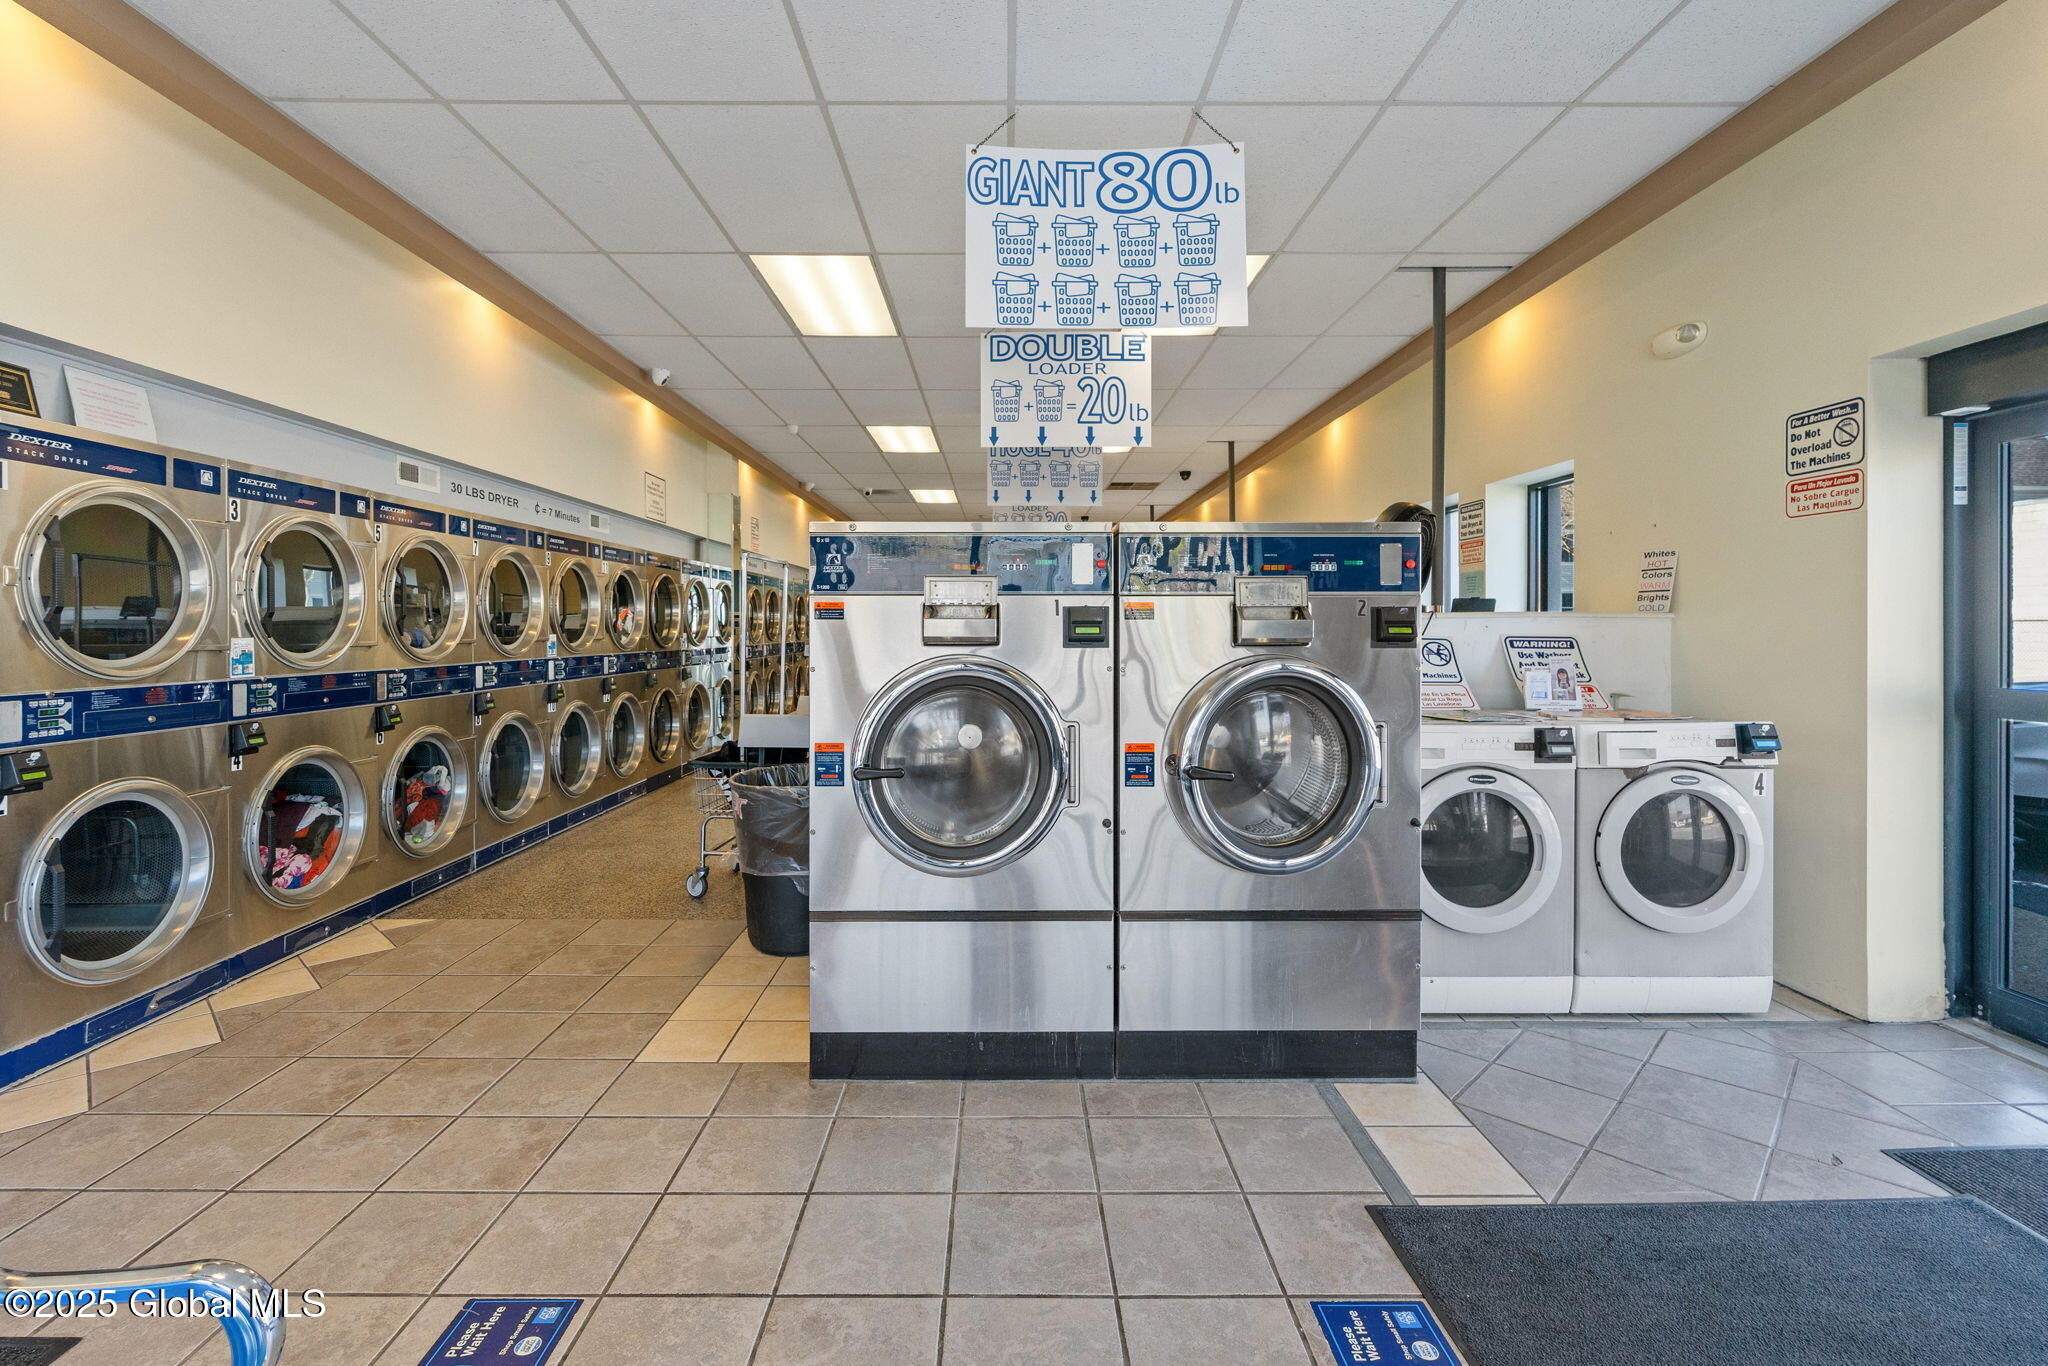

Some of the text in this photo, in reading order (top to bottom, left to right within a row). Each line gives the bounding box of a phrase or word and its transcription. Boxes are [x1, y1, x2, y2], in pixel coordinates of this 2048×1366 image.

[967, 156, 1095, 208] GIANT
[1096, 149, 1212, 214] 80
[990, 334, 1146, 362] DOUBLE
[1028, 363, 1106, 375] LOADER
[1077, 376, 1148, 424] 20 lb
[1810, 412, 1830, 423] Better
[8, 432, 73, 451] DEXTER
[1791, 429, 1821, 442] Do Not
[7, 446, 88, 466] STACK DRYER
[1791, 439, 1832, 456] Overload
[1791, 452, 1851, 470] The Machines
[238, 477, 277, 490] DEXTER
[238, 487, 287, 500] STACK DRYER
[1804, 492, 1827, 501] Sobre
[1830, 487, 1860, 497] Cargue
[230, 500, 238, 521] 3
[450, 482, 462, 494] 30
[465, 486, 485, 500] LBS
[488, 492, 519, 508] DRYER
[549, 508, 553, 517] 7
[555, 510, 581, 524] Minutes
[1797, 500, 1852, 512] Las Maquinas
[375, 525, 381, 542] 5
[474, 541, 478, 555] 7
[1637, 594, 1669, 602] Brights
[1054, 600, 1059, 616] 1
[1358, 600, 1366, 616] 2
[234, 756, 240, 769] 4
[1755, 773, 1764, 795] 4
[444, 1322, 480, 1358] Please
[460, 1305, 506, 1358] Wait Here
[498, 1339, 514, 1356] Shop
[510, 1323, 525, 1340] Small
[1349, 1310, 1381, 1362] Wait Here
[1342, 1326, 1367, 1362] Please
